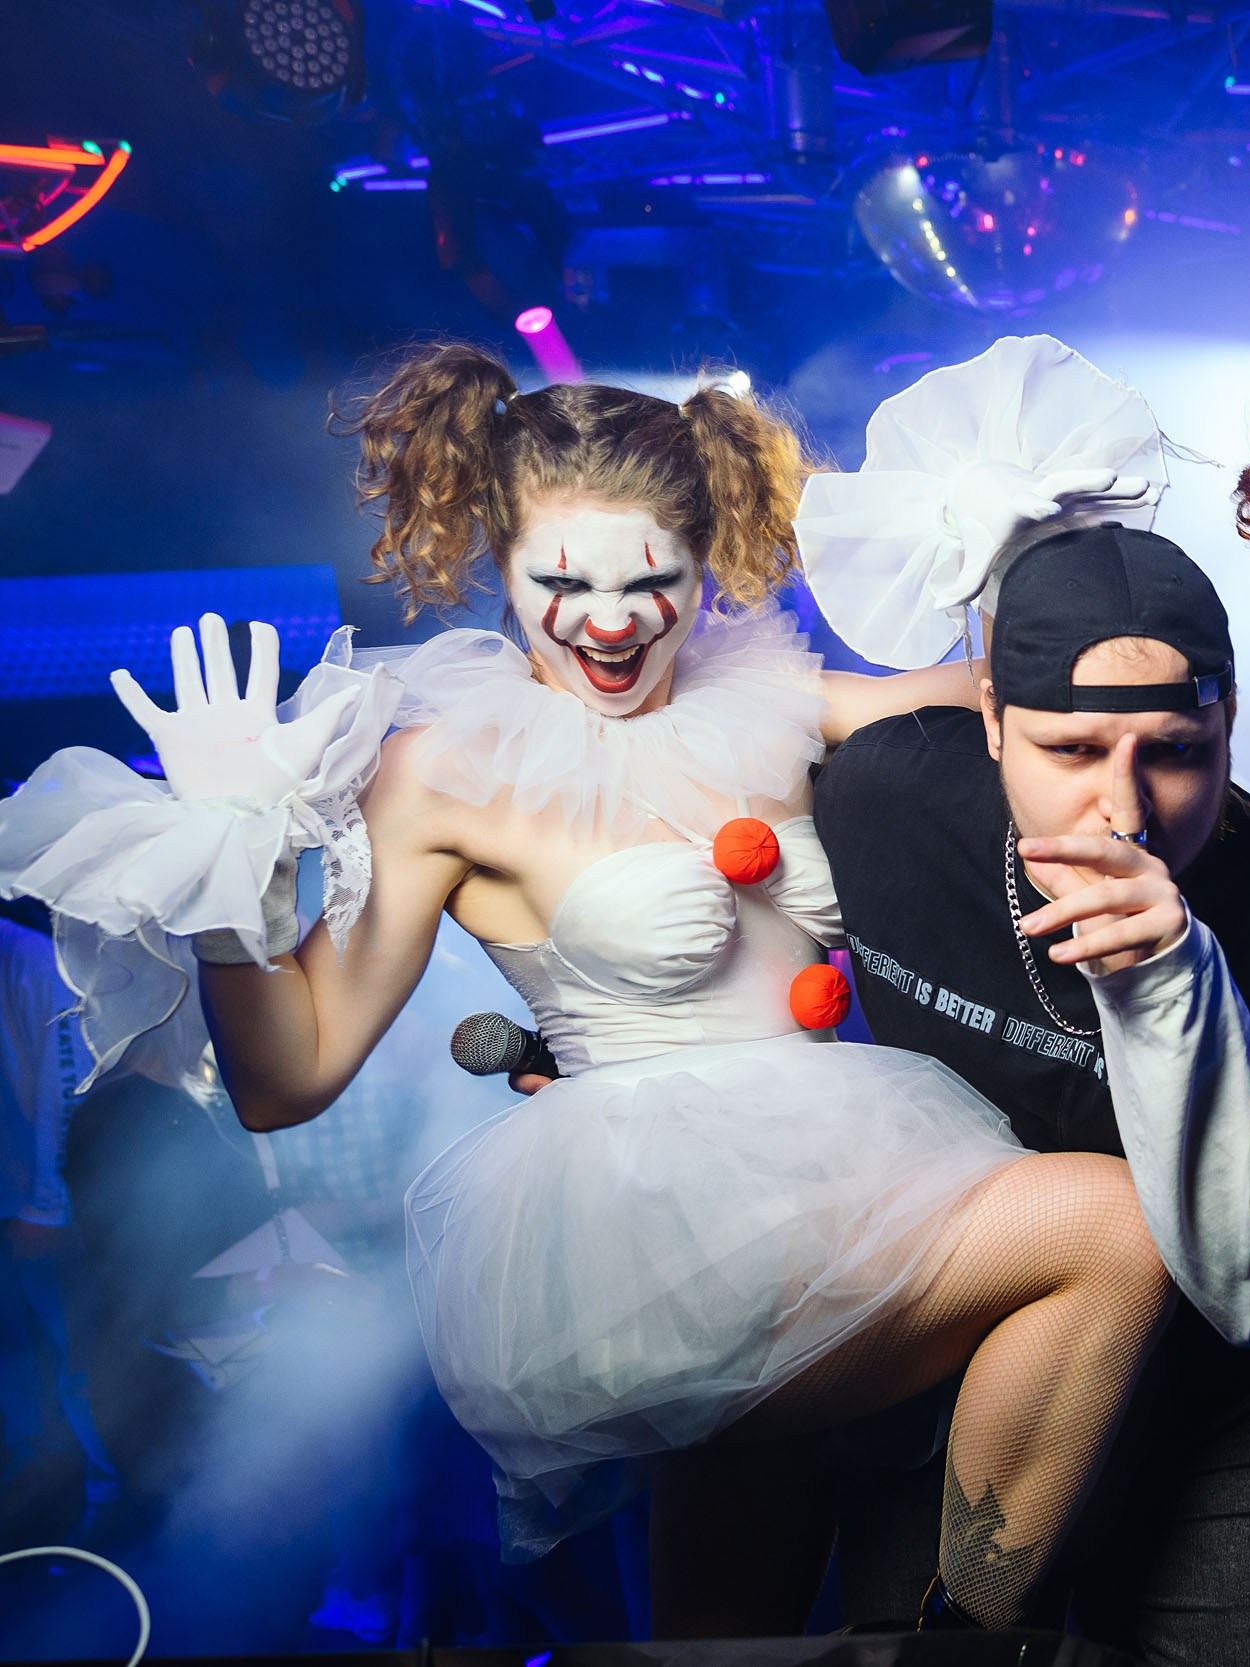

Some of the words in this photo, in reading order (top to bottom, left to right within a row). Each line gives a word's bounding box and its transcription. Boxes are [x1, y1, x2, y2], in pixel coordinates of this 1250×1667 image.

[914, 978, 932, 1005] IS
[934, 988, 996, 1034] BETTER
[1001, 1017, 1095, 1068] DIFFERENT
